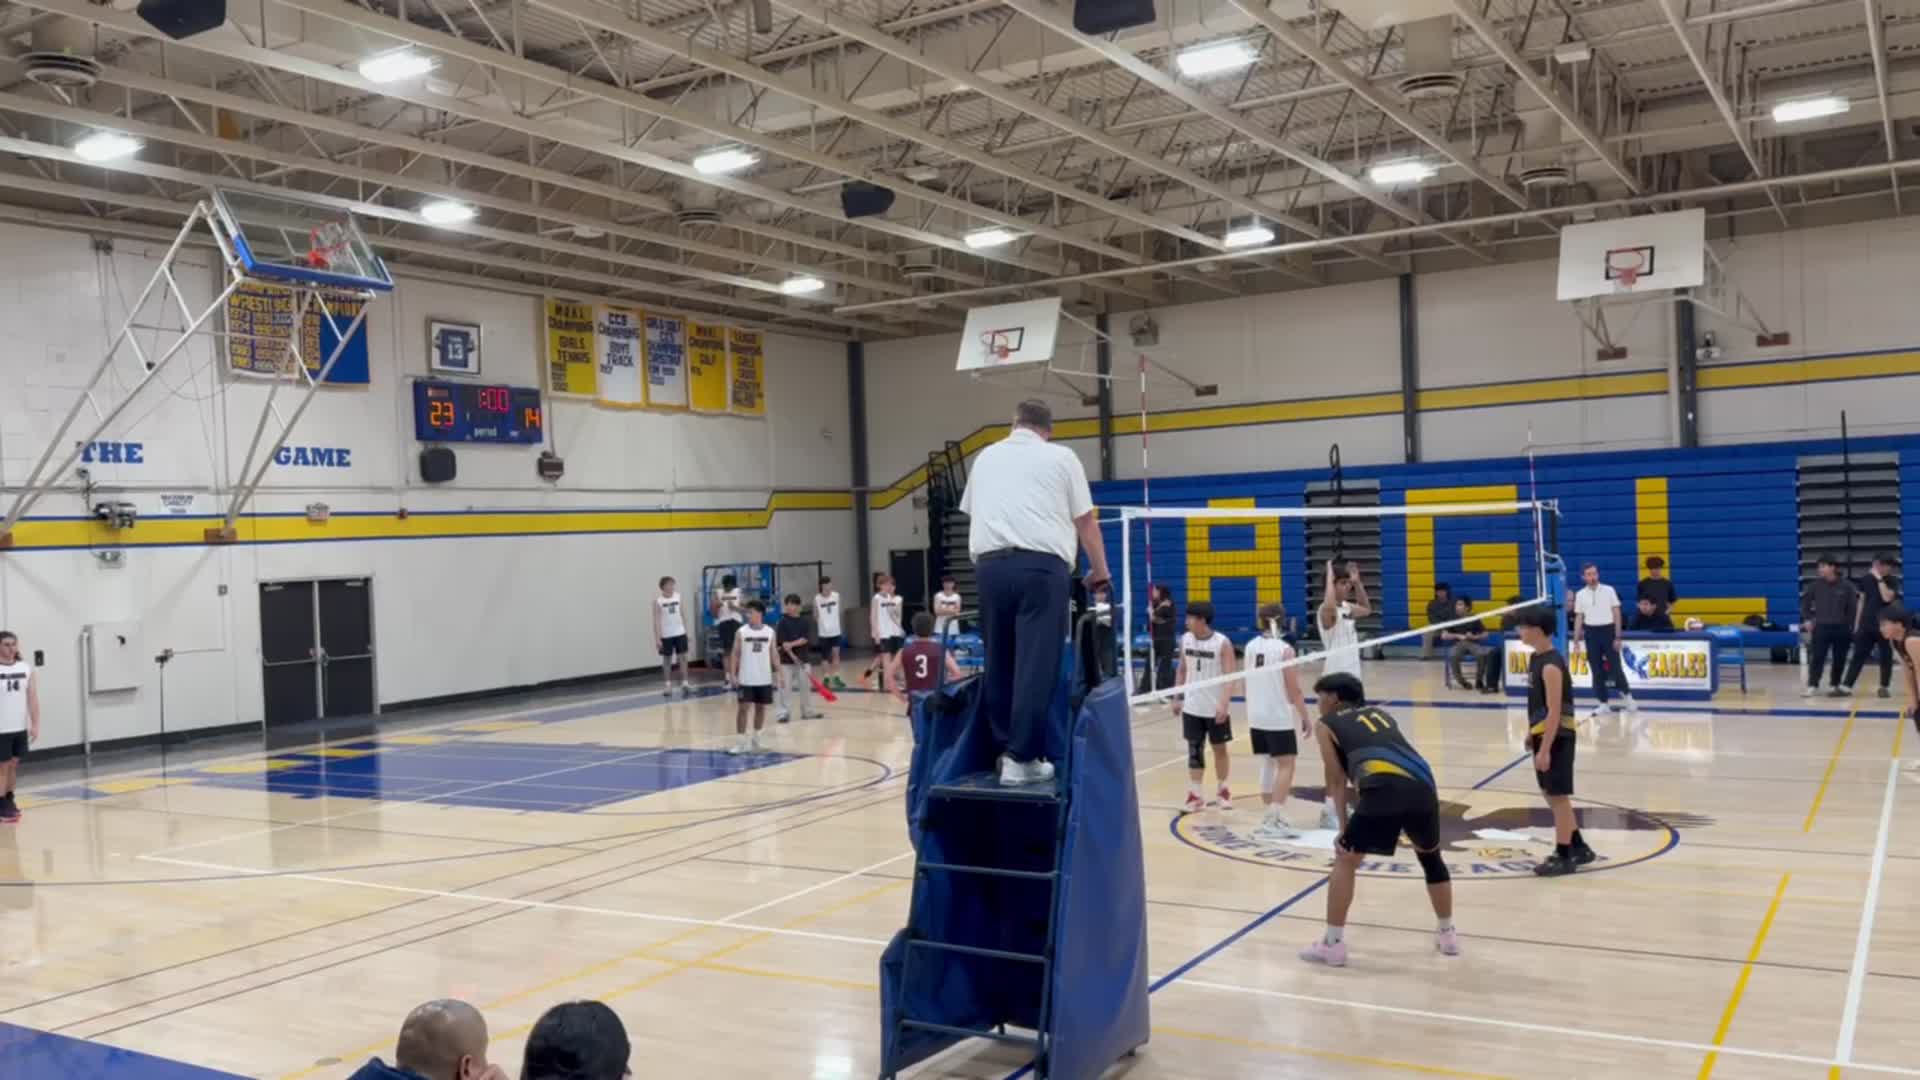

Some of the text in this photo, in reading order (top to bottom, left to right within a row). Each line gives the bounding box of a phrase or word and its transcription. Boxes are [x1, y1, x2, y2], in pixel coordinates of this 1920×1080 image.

[448, 344, 463, 360] 13
[557, 350, 591, 364] TENNIS
[607, 352, 634, 367] TRACK
[430, 401, 455, 426] 23
[524, 407, 542, 429] 14
[76, 441, 144, 464] THE
[274, 446, 351, 468] GAME
[914, 655, 928, 678] 3
[1647, 650, 1708, 678] EAGLES
[7, 679, 20, 692] 14
[1356, 711, 1391, 733] 11
